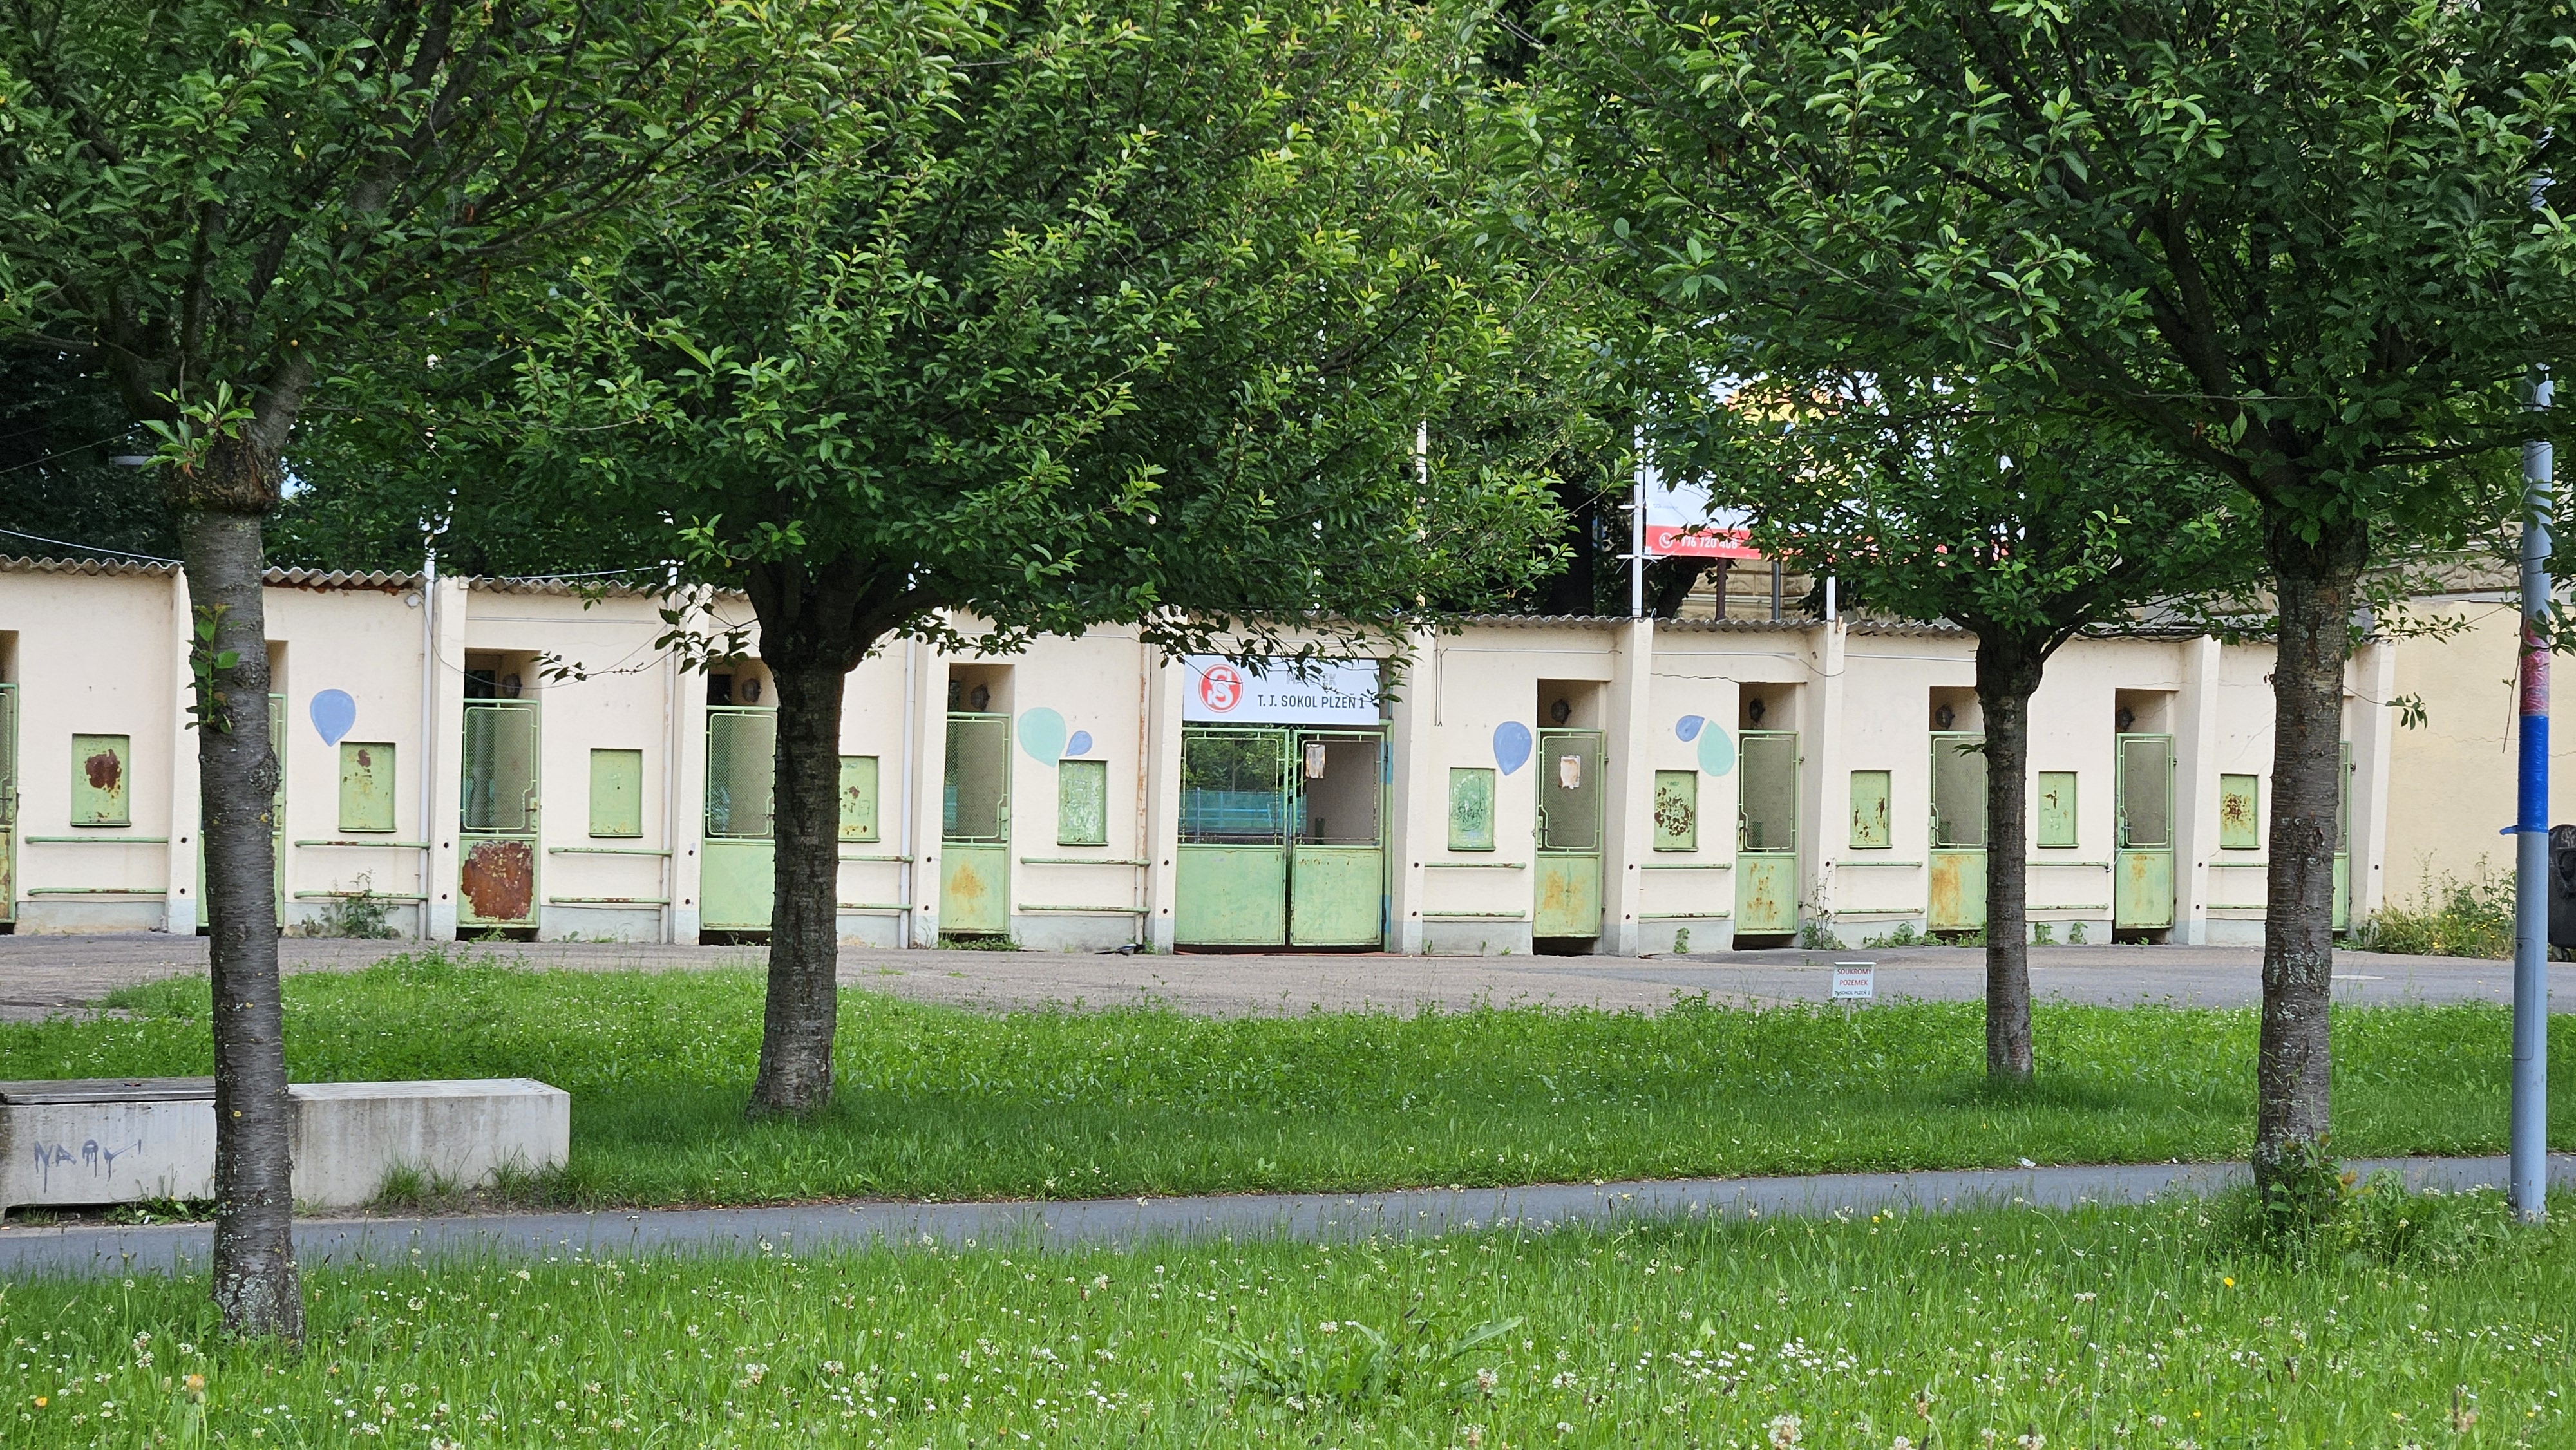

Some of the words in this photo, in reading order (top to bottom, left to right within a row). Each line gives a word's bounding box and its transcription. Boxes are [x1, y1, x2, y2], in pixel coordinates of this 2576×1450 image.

[1257, 694, 1266, 707] T.
[1269, 695, 1278, 707] J.
[1281, 695, 1318, 708] SOKOL
[1321, 693, 1356, 709] PLZEŇ
[1359, 697, 1365, 709] 1
